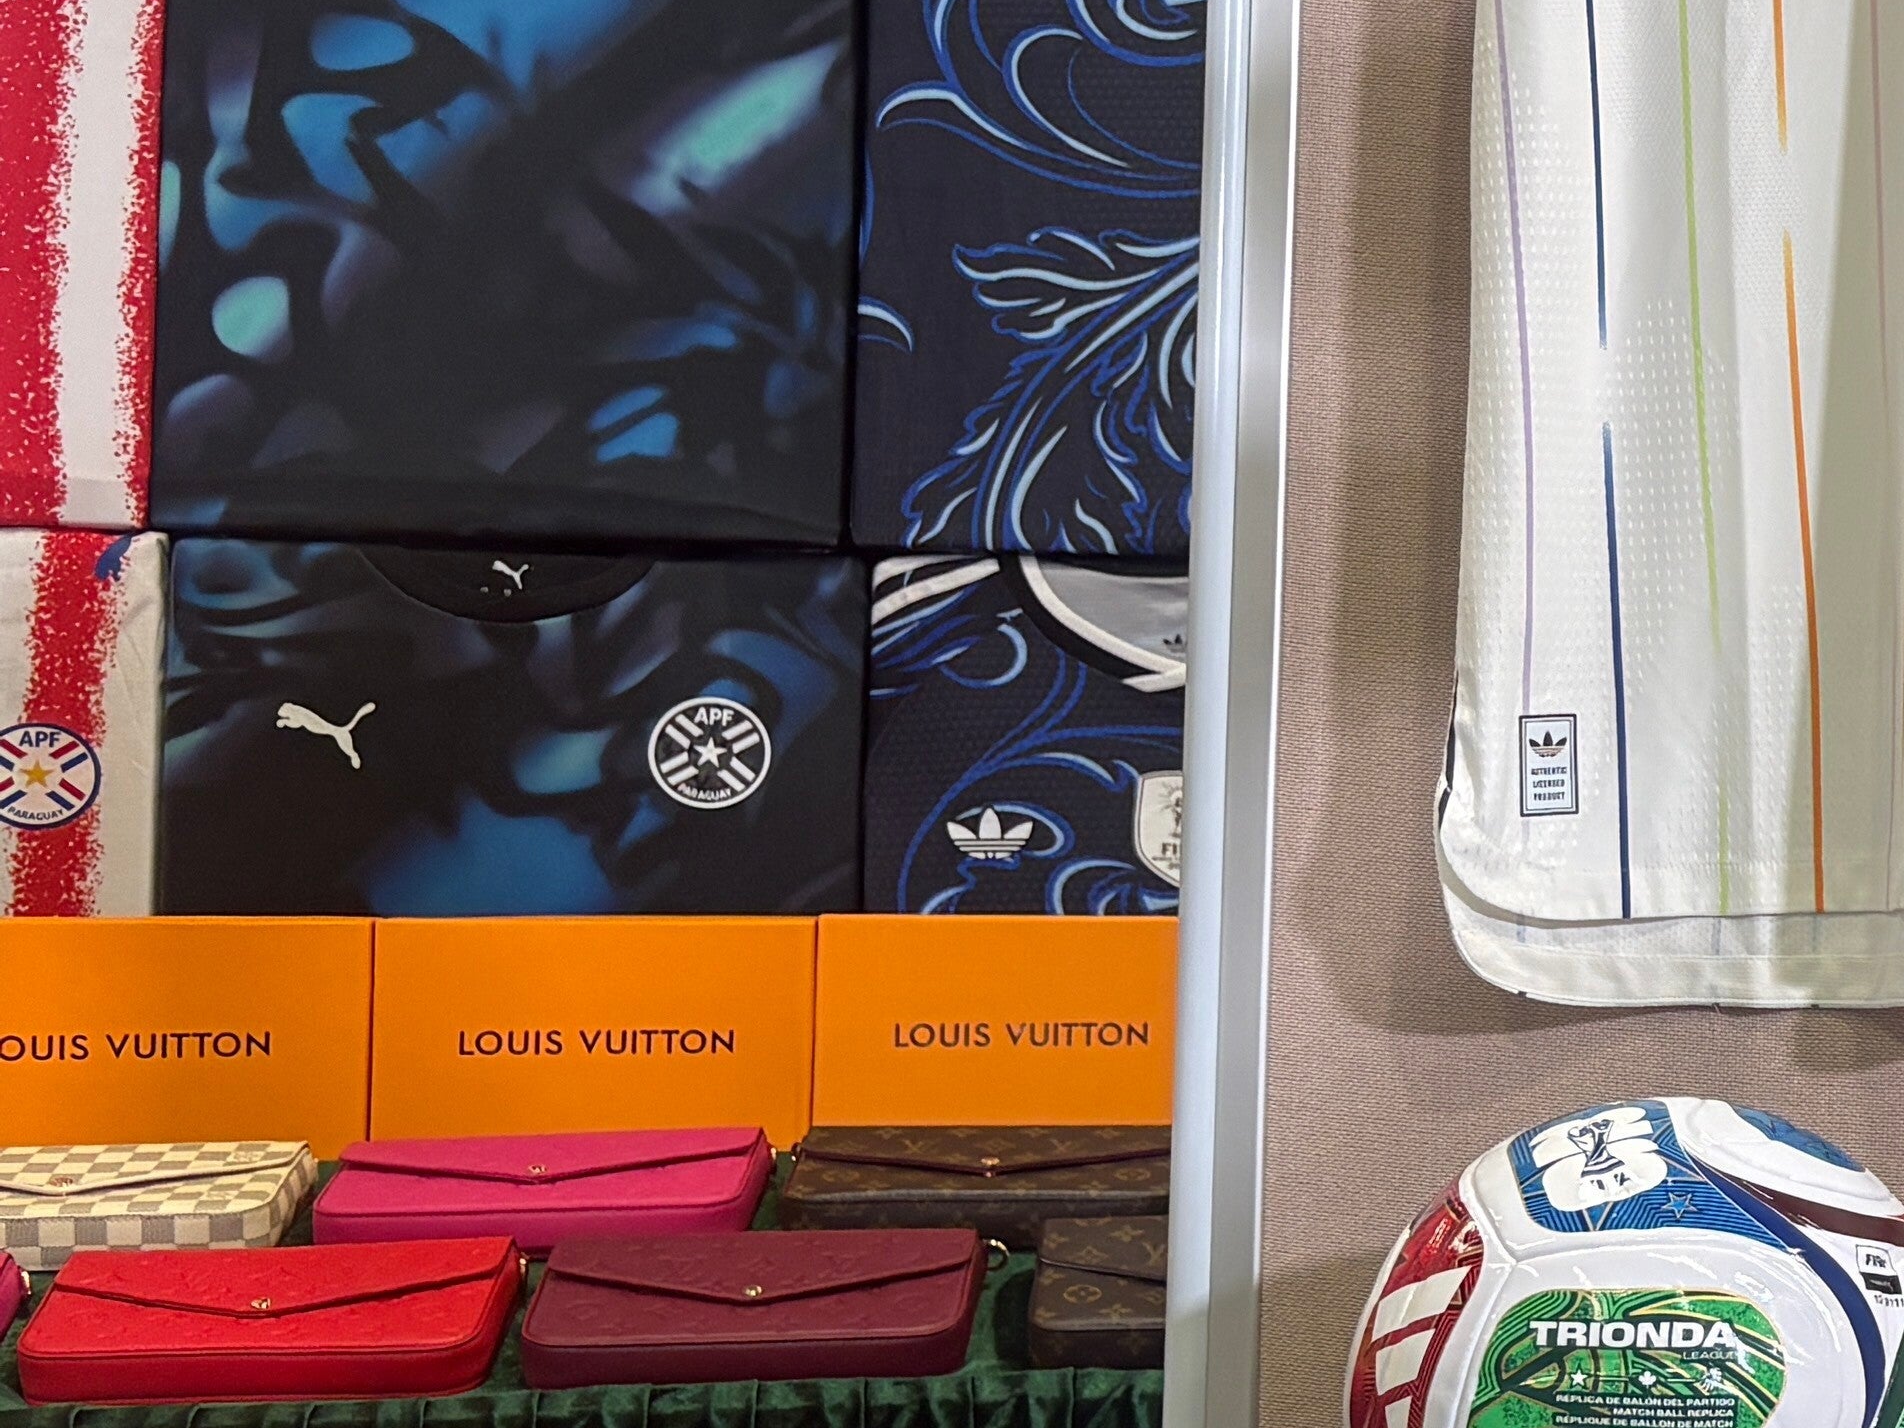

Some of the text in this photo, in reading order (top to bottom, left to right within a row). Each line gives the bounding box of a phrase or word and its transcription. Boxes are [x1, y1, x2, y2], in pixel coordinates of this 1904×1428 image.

[693, 706, 735, 727] APF
[18, 730, 62, 748] APF
[677, 782, 732, 801] PARAGUAY
[7, 806, 64, 821] PARAGUAY
[458, 1029, 735, 1056] LOUIS VUITTON
[894, 1021, 1149, 1048] LOUIS VUITTON
[105, 1030, 272, 1059] VUITTON
[1529, 1321, 1737, 1348] TRIONDA
[1605, 1396, 1621, 1405] DE
[1686, 1397, 1736, 1407] PARTIDO
[1612, 1407, 1734, 1418] MATCH BALL REPLICA
[1612, 1418, 1628, 1427] DE
[1629, 1419, 1676, 1428] BALLON
[1677, 1420, 1692, 1428] DE
[1693, 1419, 1734, 1428] MATCH
